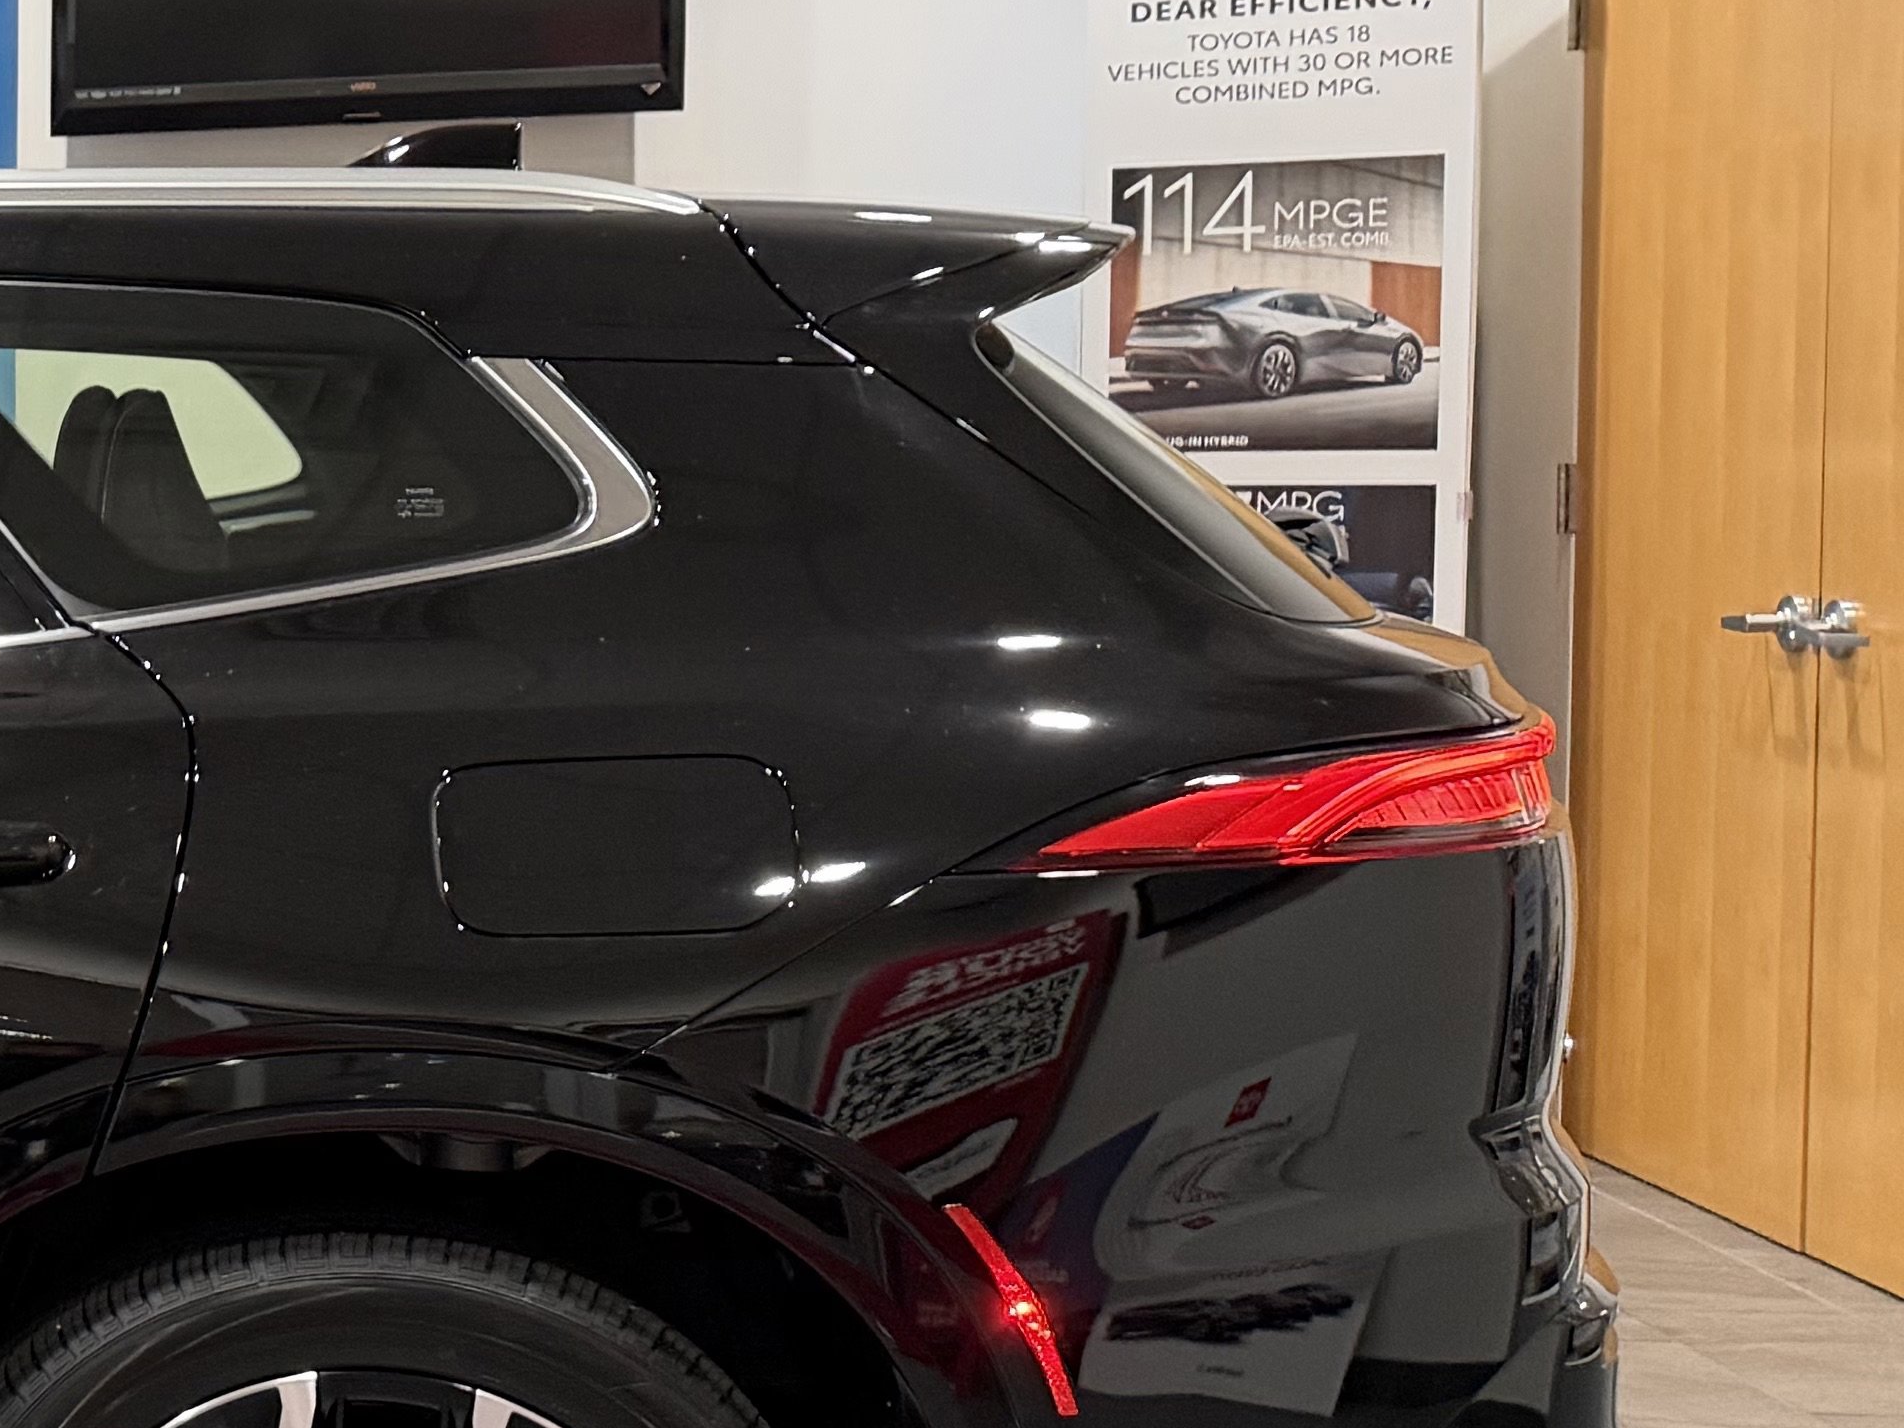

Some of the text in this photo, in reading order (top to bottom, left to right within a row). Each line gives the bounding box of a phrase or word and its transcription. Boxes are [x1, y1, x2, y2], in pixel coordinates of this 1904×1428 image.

[1187, 24, 1371, 52] TOYOTA HAS 18
[1108, 46, 1454, 82] VEHICLES WITH 30 OR MORE
[1175, 77, 1381, 104] COMBINED MPG.
[1123, 170, 1389, 256] 114 MPGE
